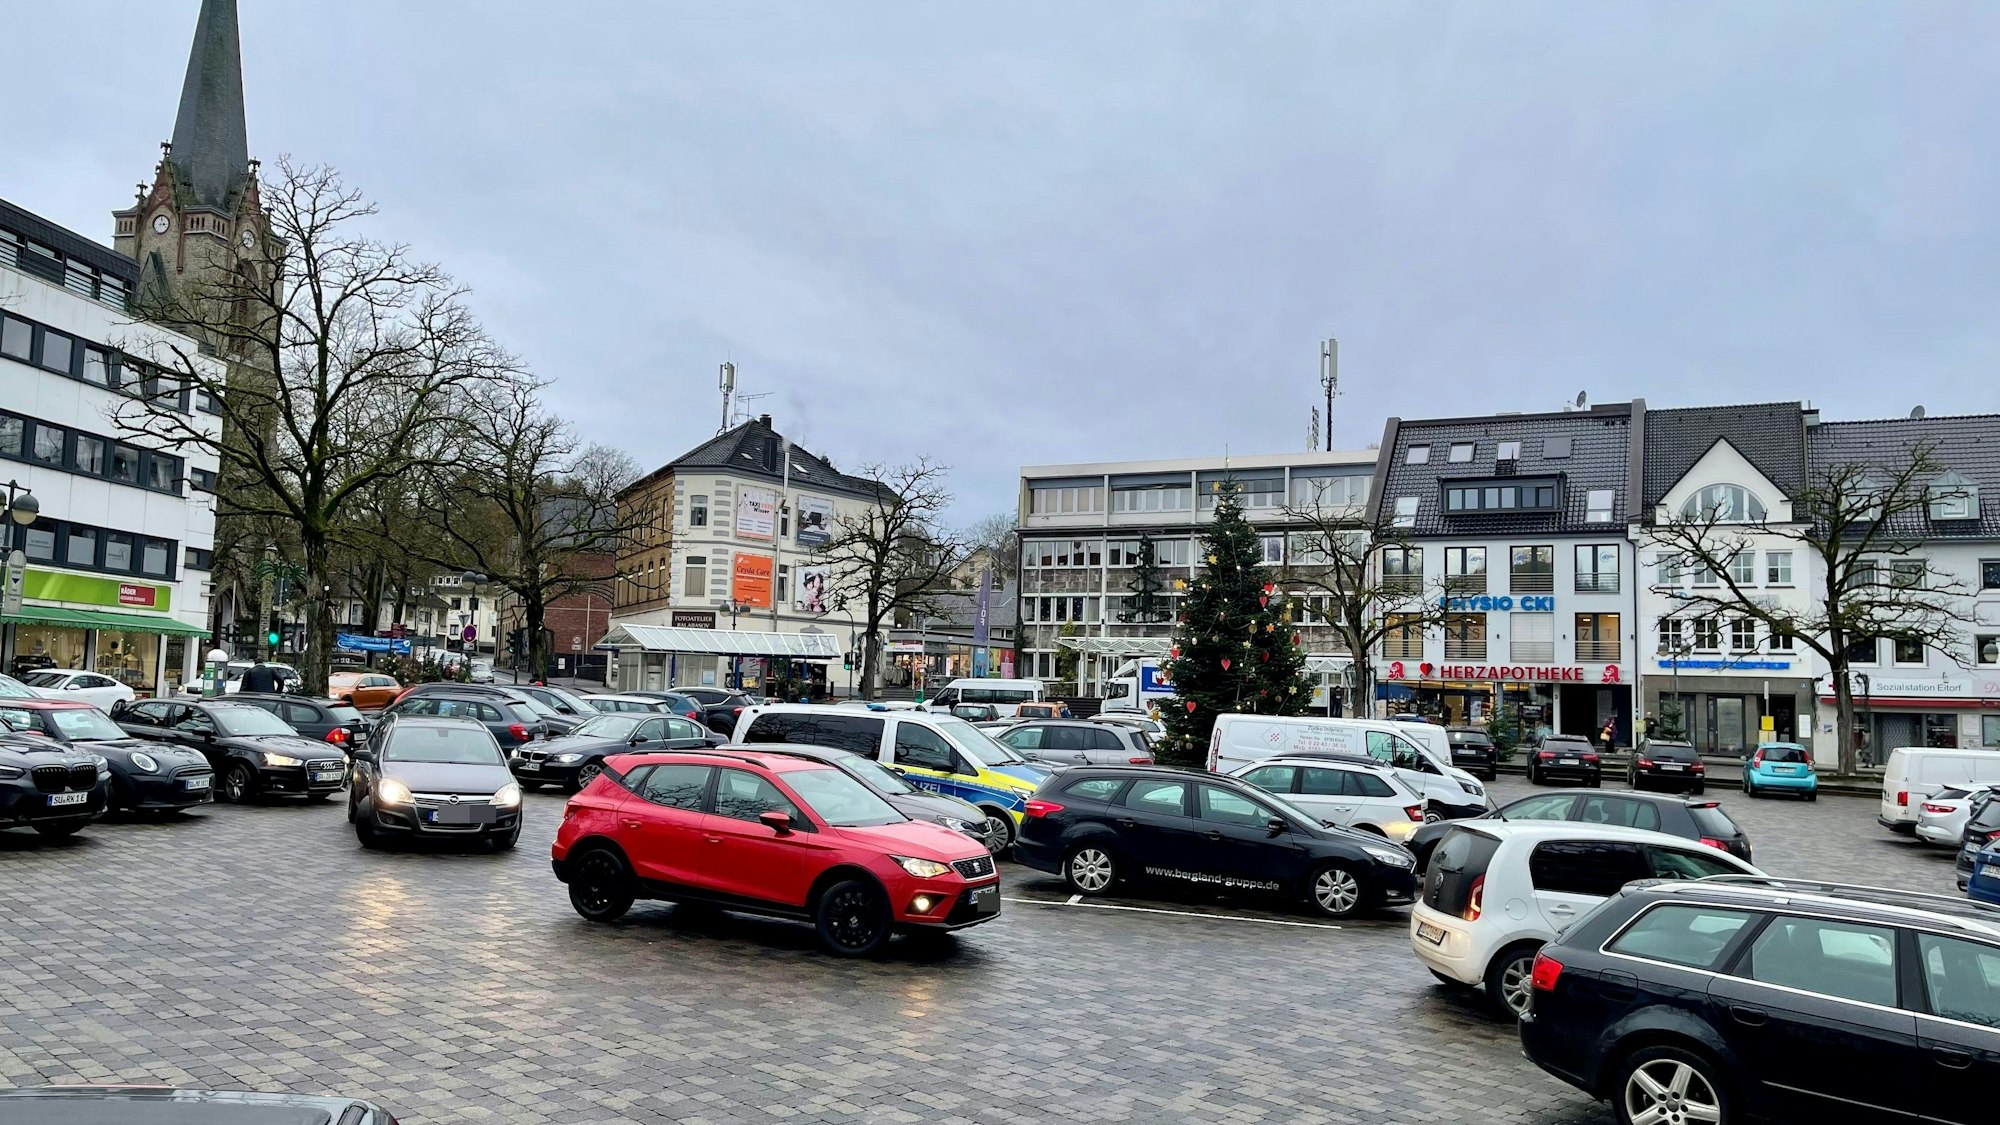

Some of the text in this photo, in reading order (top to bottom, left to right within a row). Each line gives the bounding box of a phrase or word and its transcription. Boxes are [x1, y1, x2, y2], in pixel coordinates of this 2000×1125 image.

[1520, 596, 1554, 611] CKI
[1440, 665, 1584, 681] HERZAPOTHEKE
[1876, 682, 1962, 692] Sozialstation Eitorf
[53, 796, 64, 805] SU
[1145, 866, 1280, 890] www.bergland-gruppe.de
